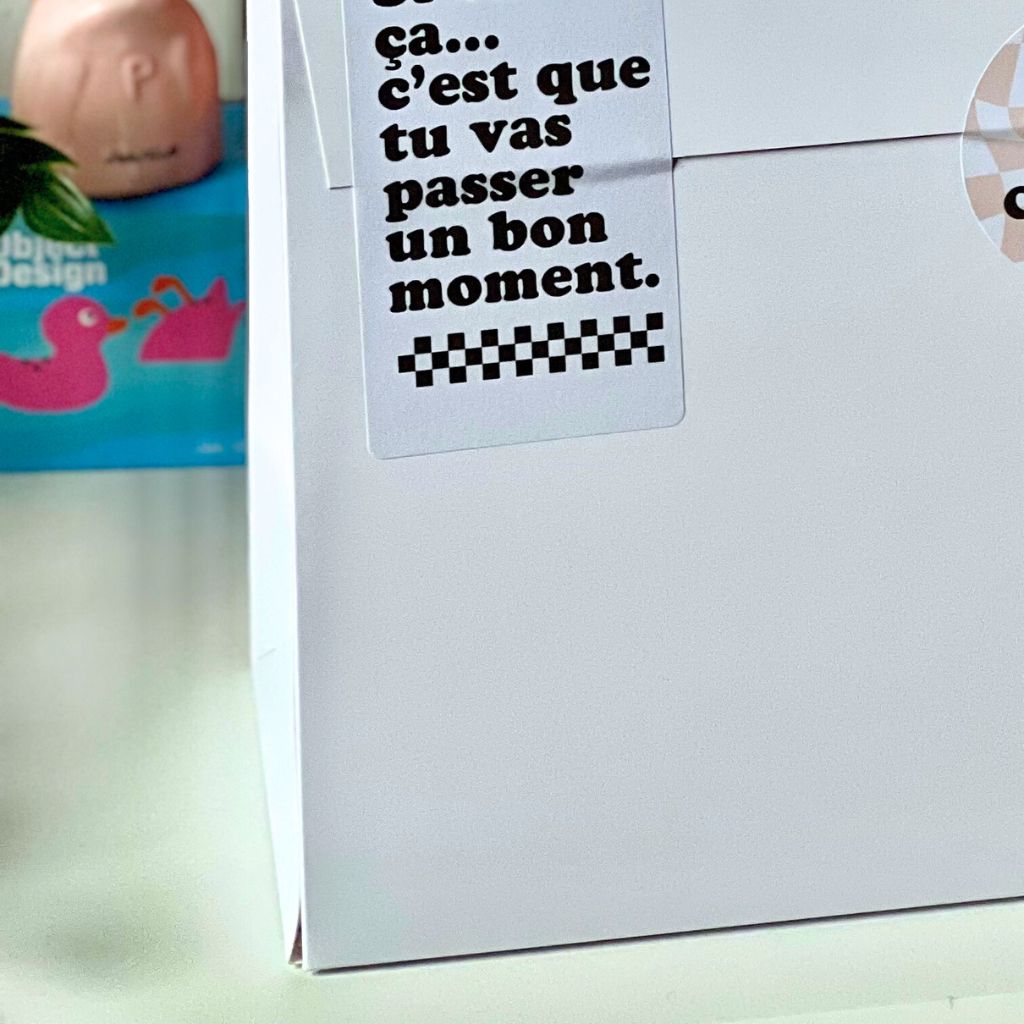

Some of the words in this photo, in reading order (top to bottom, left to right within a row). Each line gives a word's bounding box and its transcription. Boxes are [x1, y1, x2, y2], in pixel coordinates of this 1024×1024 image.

[374, 23, 501, 71] ça...
[377, 61, 519, 111] c’est
[536, 55, 651, 106] que
[379, 123, 451, 162] tu
[468, 114, 572, 153] vas
[382, 164, 584, 223] passer
[385, 225, 471, 263] un
[487, 210, 609, 252] bon
[388, 252, 660, 313] moment.
